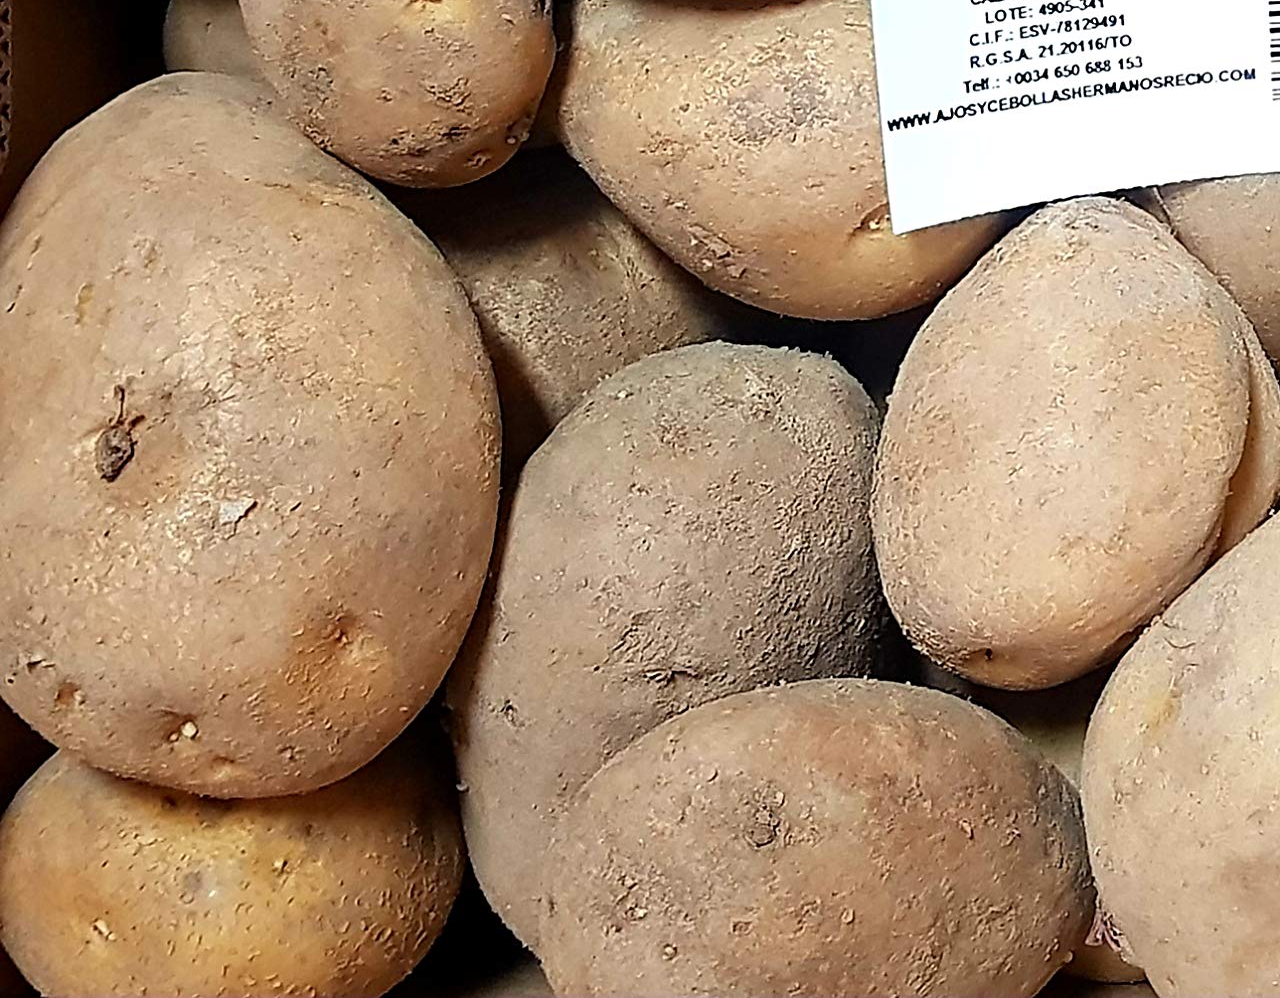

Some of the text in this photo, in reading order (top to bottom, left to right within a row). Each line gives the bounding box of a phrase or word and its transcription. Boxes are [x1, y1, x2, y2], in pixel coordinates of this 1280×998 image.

[985, 6, 1033, 24] LOTE:
[969, 29, 1014, 46] C.I.F.:
[1054, 64, 1080, 79] 650
[1085, 59, 1111, 74] 688
[1117, 55, 1143, 70] 153
[887, 68, 1256, 132] WWW.AJOSYCEBOLLASHERMANOSRECIO.COM
